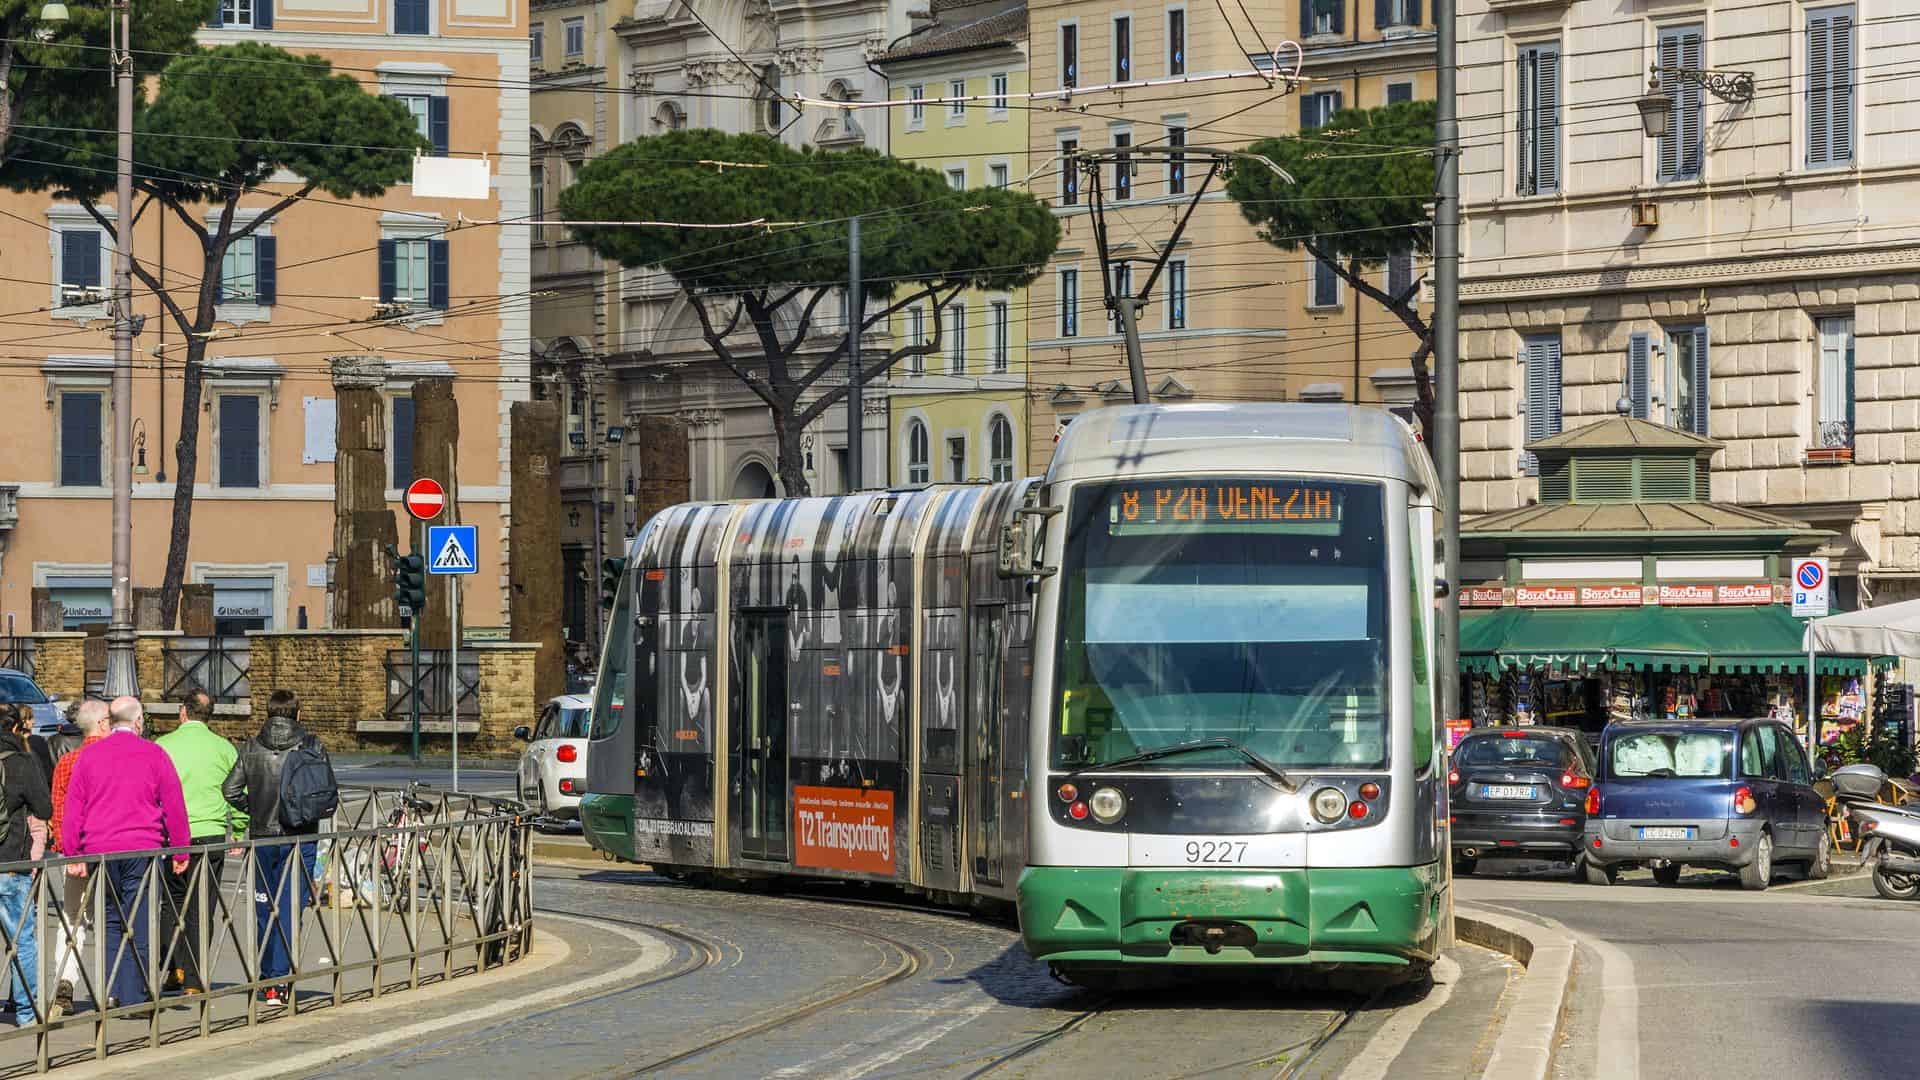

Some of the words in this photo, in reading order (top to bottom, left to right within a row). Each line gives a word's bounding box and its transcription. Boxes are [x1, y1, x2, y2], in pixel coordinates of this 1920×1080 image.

[1122, 490, 1139, 520] 8
[1218, 487, 1331, 519] VENEZIA
[68, 607, 102, 616] UniCredit
[226, 607, 259, 616] UniCredit
[799, 810, 815, 847] T2
[816, 810, 890, 861] Trainspotting
[1186, 841, 1249, 863] 9227
